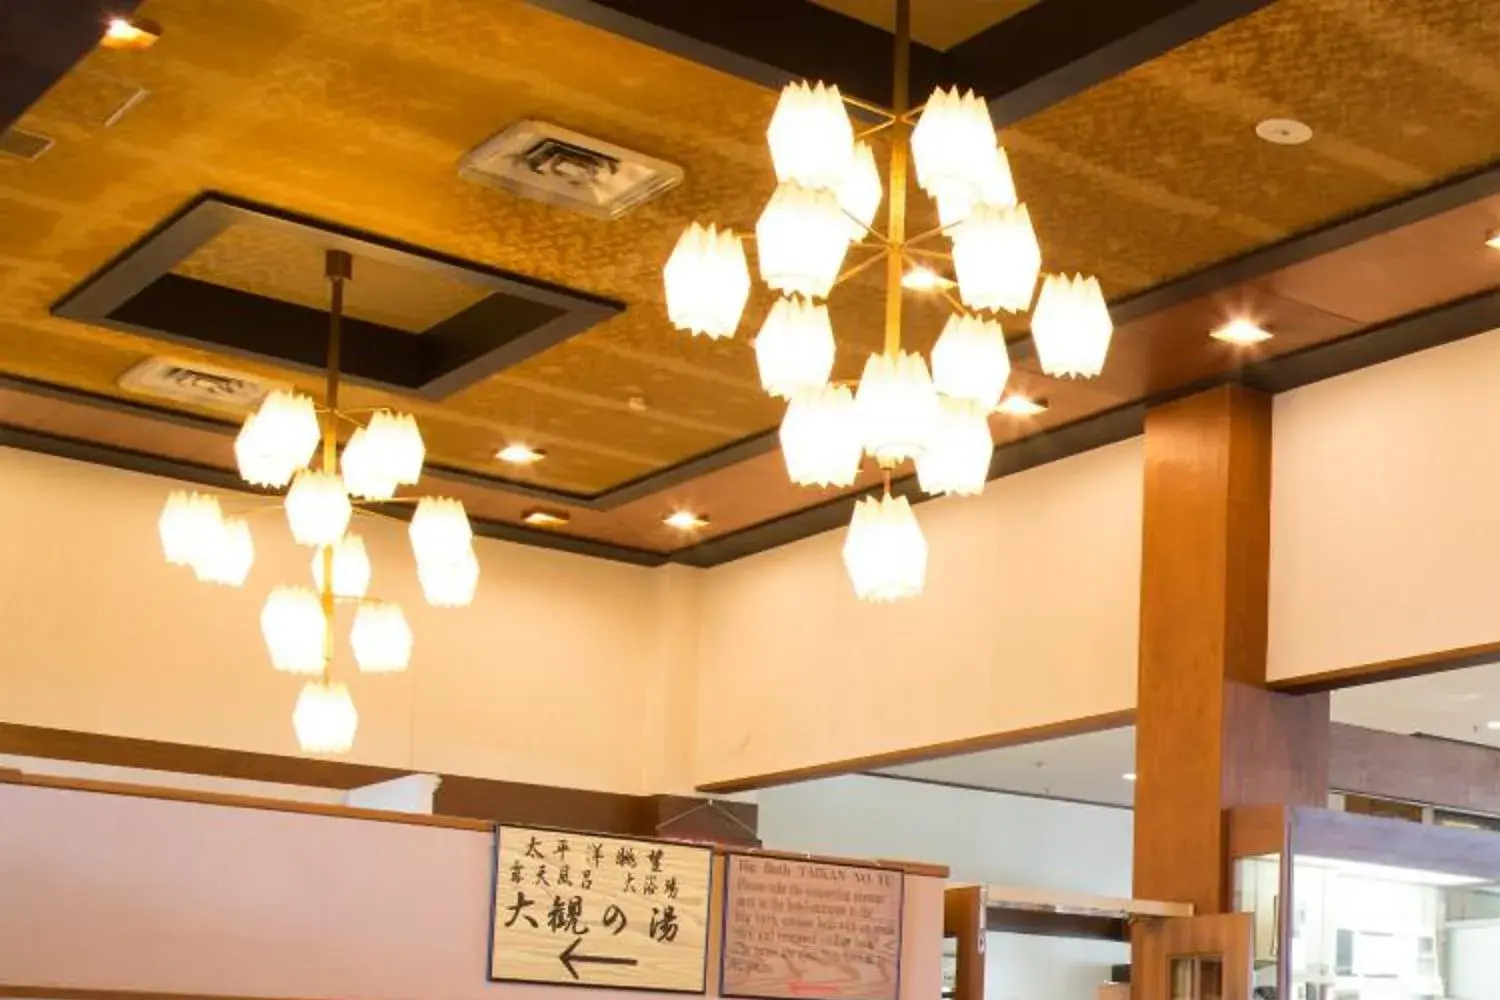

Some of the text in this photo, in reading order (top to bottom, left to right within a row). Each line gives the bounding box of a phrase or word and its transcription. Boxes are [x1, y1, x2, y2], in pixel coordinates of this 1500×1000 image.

[525, 835, 665, 873] 太平洋眺望
[510, 859, 679, 899] 露天風呂 大浴場
[504, 890, 679, 943] 大観の湯
